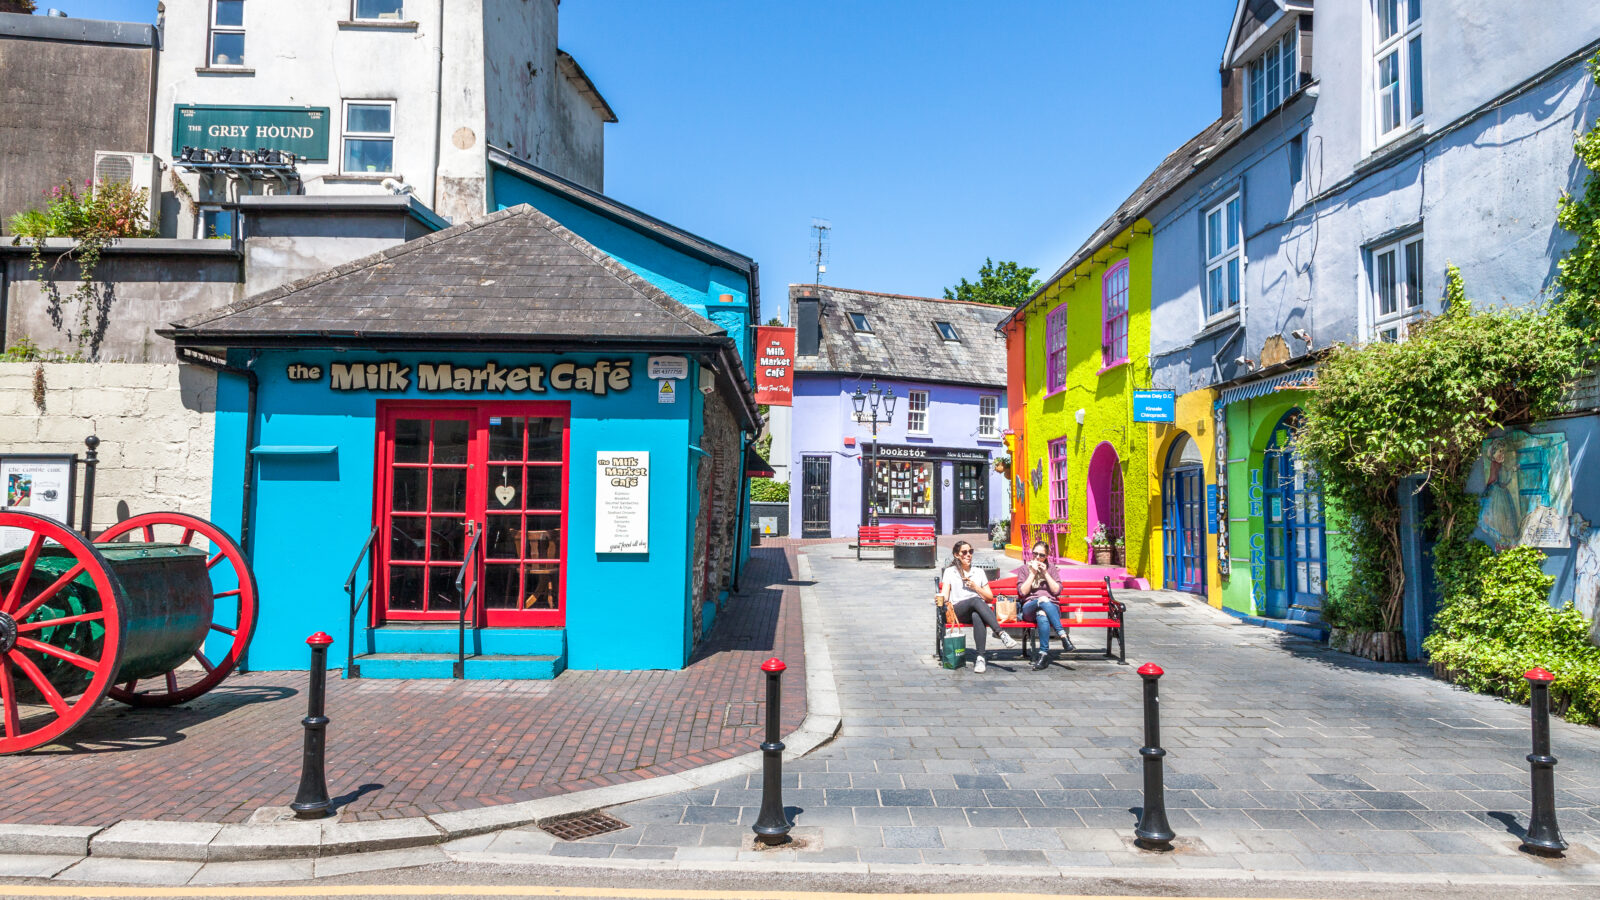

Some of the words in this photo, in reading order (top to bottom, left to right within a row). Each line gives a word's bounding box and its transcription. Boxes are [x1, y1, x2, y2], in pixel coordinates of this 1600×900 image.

[208, 124, 249, 138] GREY
[256, 125, 314, 139] HOUND
[766, 347, 785, 356] Milk
[760, 357, 791, 367] Market
[288, 363, 321, 380] the
[330, 361, 410, 391] Milk
[417, 362, 545, 392] Market
[549, 360, 633, 395] Café
[880, 446, 926, 458] bookstór
[612, 457, 639, 467] Milk
[1215, 408, 1227, 514] SMOOTHIE
[605, 467, 647, 477] Market
[1249, 468, 1264, 518] ICE
[1218, 519, 1228, 560] BAR
[1249, 532, 1267, 612] CREAM
